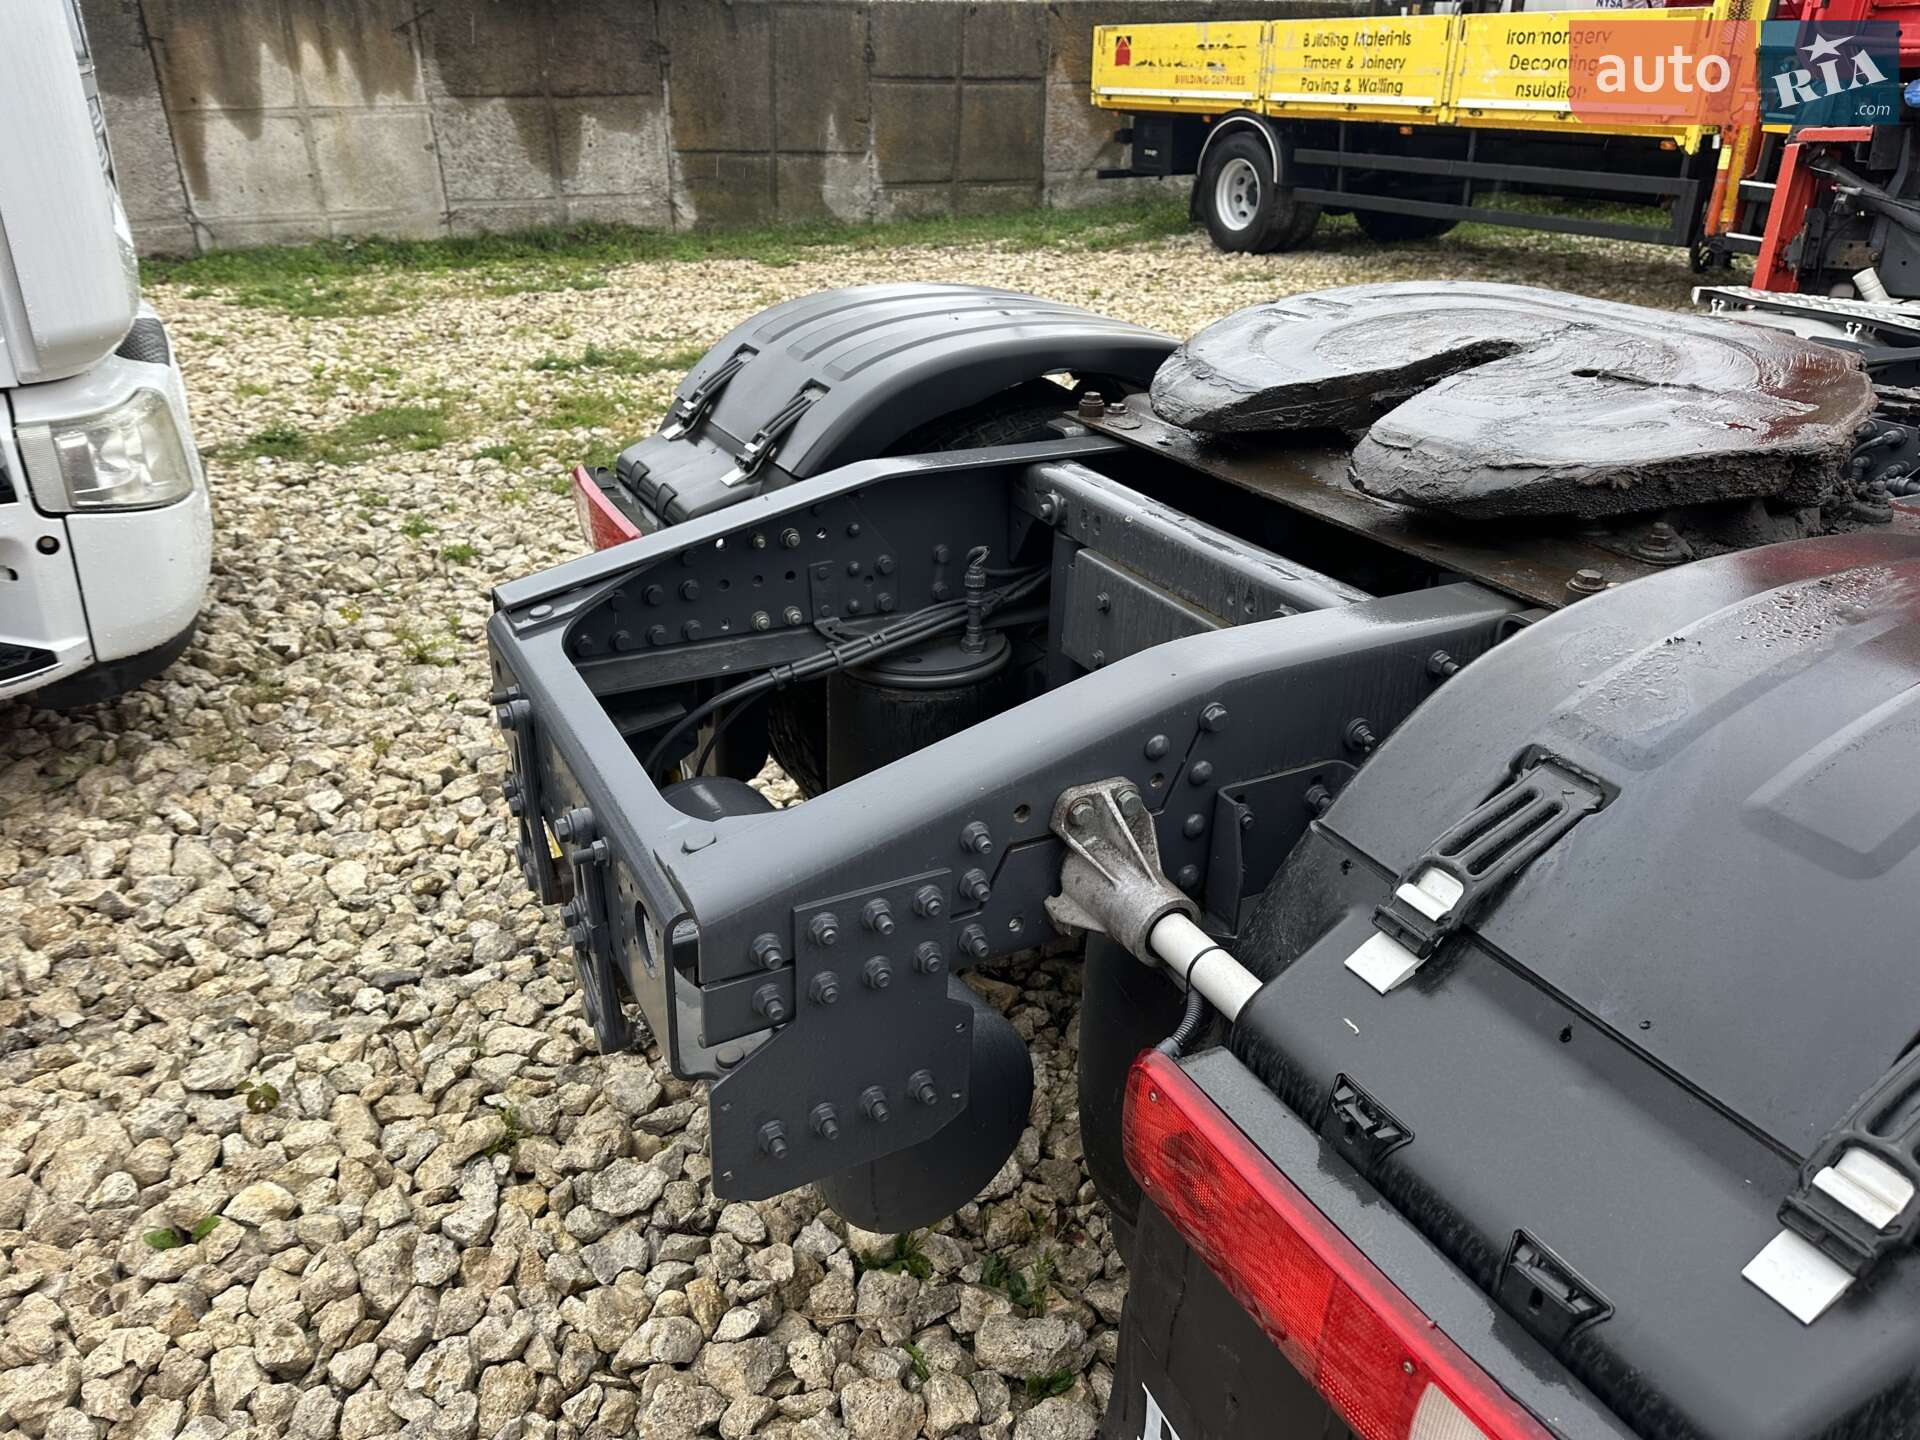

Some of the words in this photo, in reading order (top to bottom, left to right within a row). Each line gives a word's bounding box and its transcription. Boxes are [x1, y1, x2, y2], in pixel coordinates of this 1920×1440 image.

[1303, 55, 1342, 70] Timber
[1345, 55, 1354, 69] &
[1360, 56, 1407, 73] Joinery
[1301, 77, 1339, 95] Paving
[1343, 77, 1352, 92] &
[1358, 77, 1404, 95] Walling
